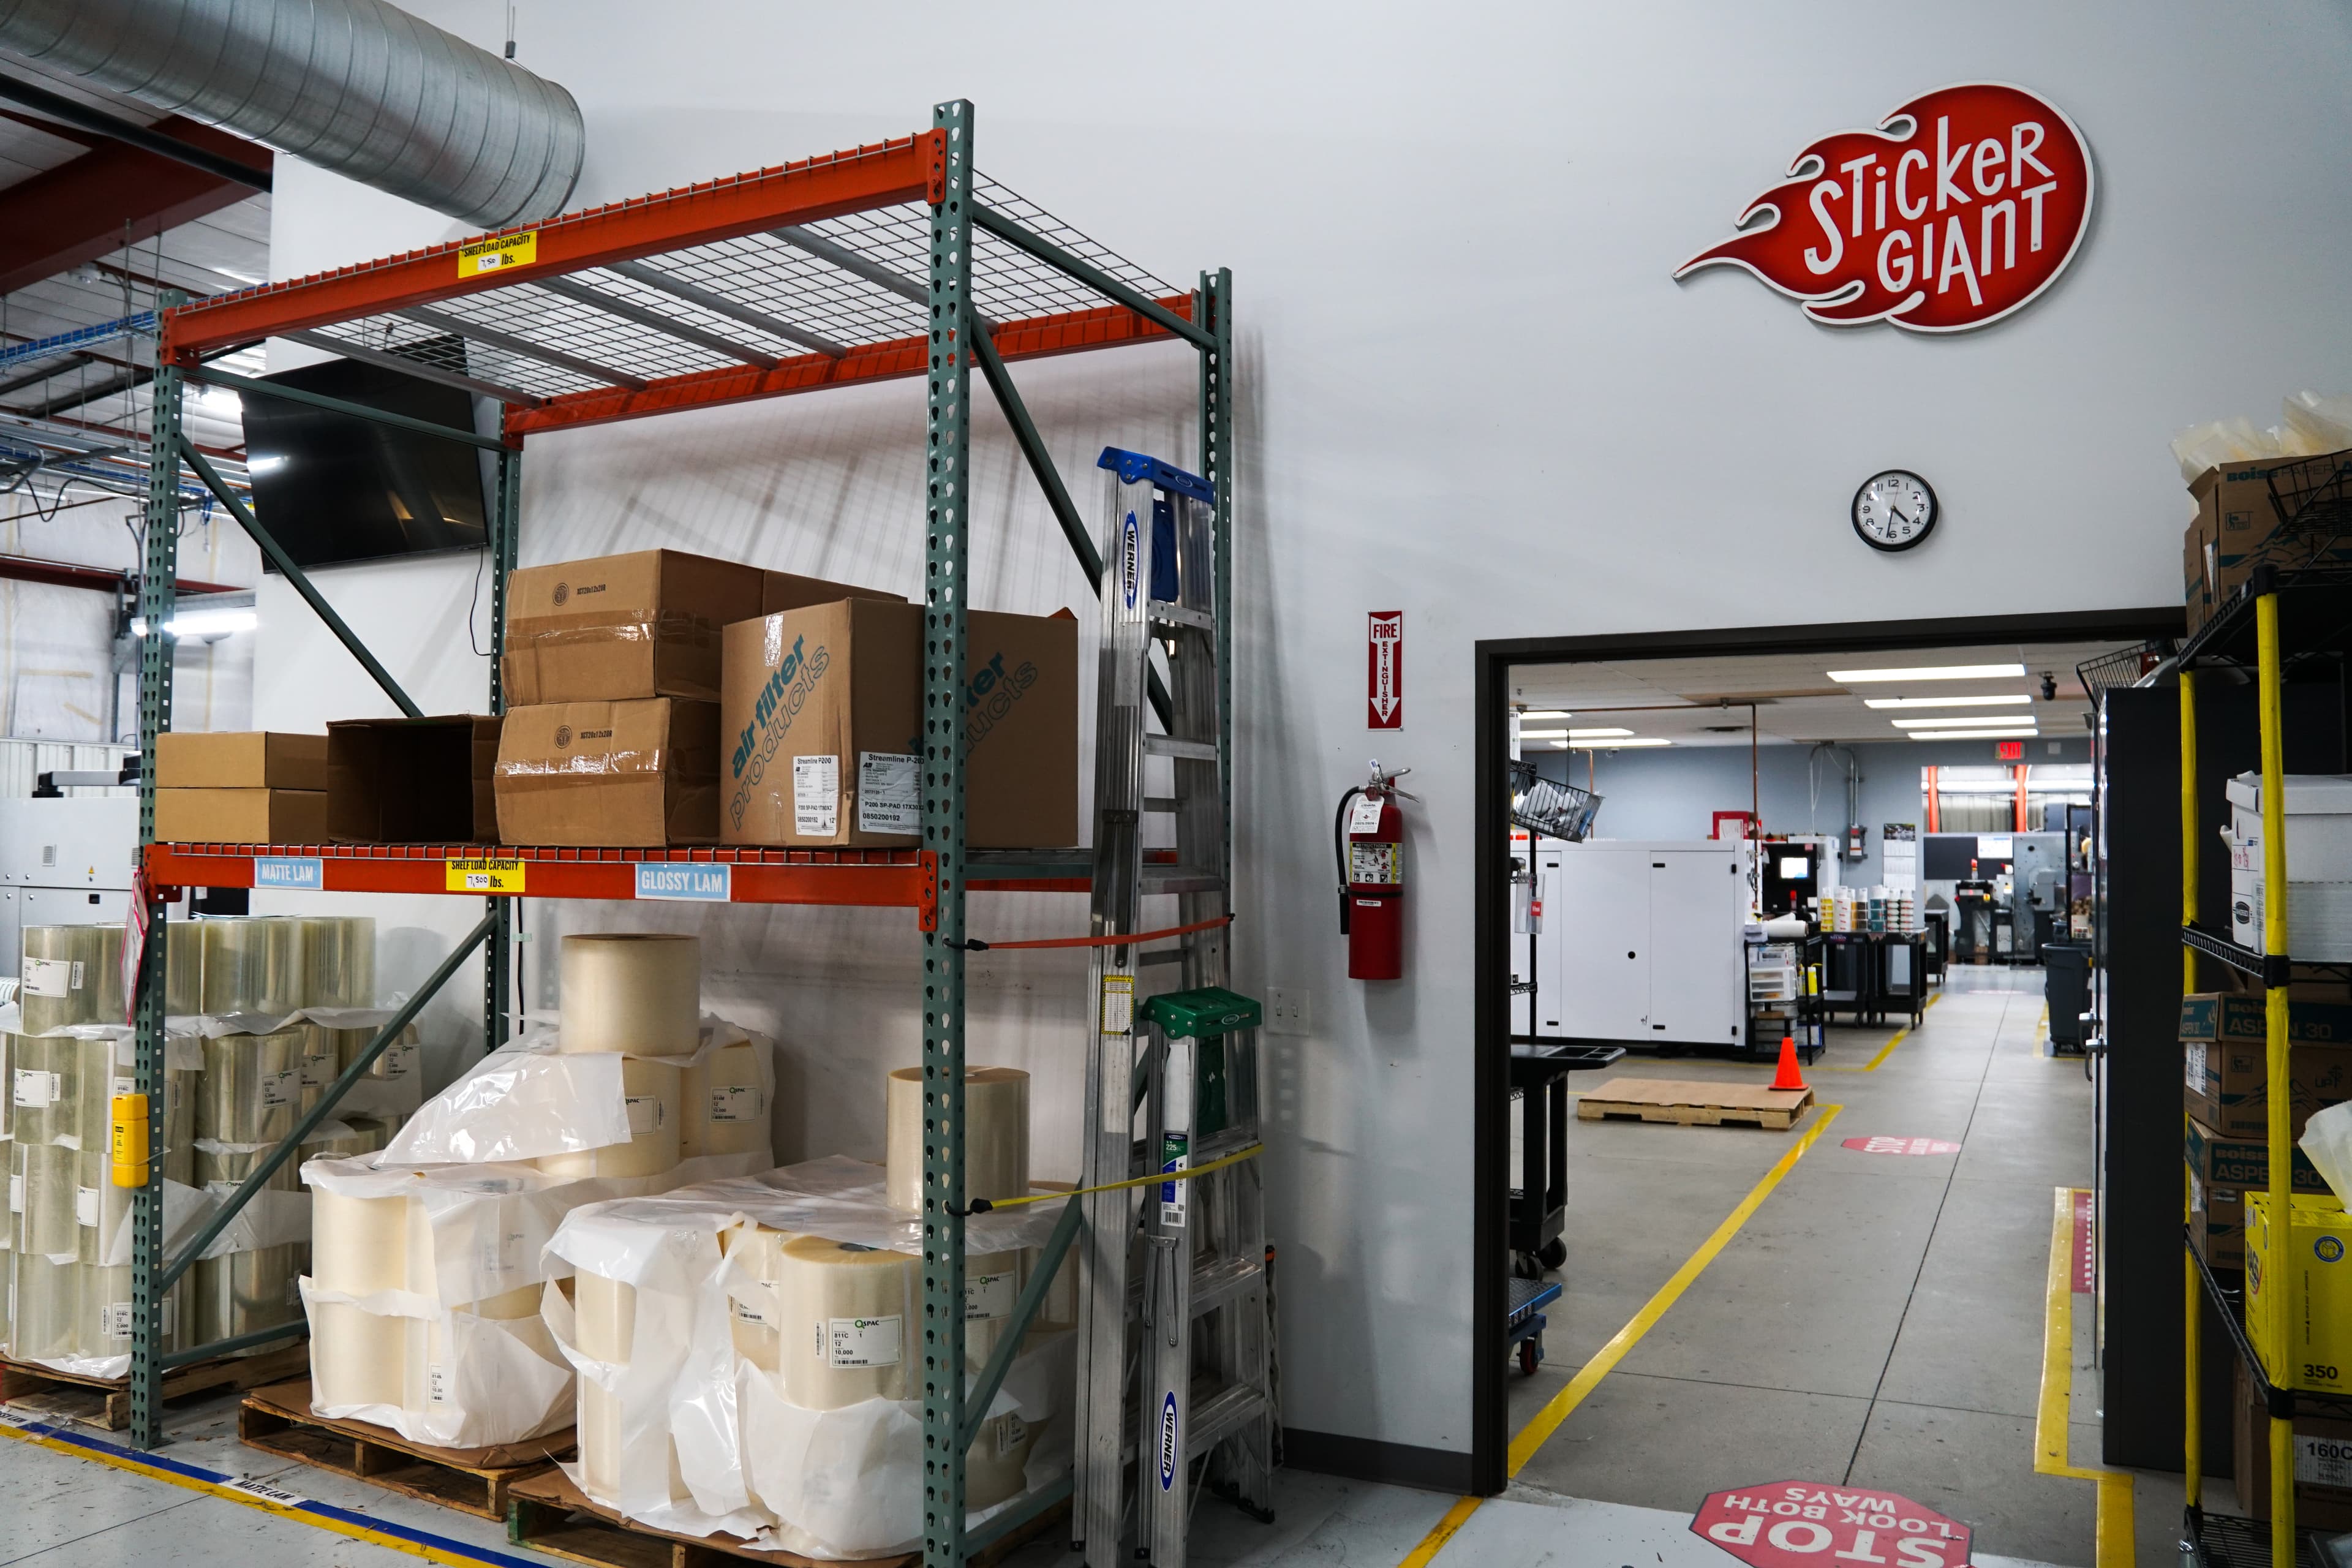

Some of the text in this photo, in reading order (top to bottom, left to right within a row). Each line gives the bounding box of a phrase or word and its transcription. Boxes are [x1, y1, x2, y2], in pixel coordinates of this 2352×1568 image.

[464, 234, 531, 257] SHELF LOAD CAPACITY
[502, 254, 515, 265] lbs.
[1917, 503, 1925, 512] 3
[1373, 623, 1397, 638] FIRE
[733, 718, 756, 779] air
[756, 633, 804, 729] filter
[729, 645, 830, 831] products
[869, 754, 905, 763] Streamline
[862, 813, 900, 821] 0850200192
[262, 864, 314, 882] MATTE LAM
[451, 861, 518, 872] SHELF LOAD CAPACITY
[489, 875, 504, 888] lbs.
[641, 870, 723, 892] GLOSSY LAM
[2305, 1022, 2332, 1039] 30
[2294, 1168, 2321, 1186] 30
[854, 1319, 880, 1329] QSPAC
[2304, 1364, 2339, 1379] 350
[1163, 1412, 1174, 1474] WERNER
[233, 1480, 295, 1501] MATTE LAM
[1785, 1487, 1896, 1513] WAYS
[1724, 1494, 1950, 1537] LOOK BOTH
[1708, 1515, 1947, 1568] STOP
